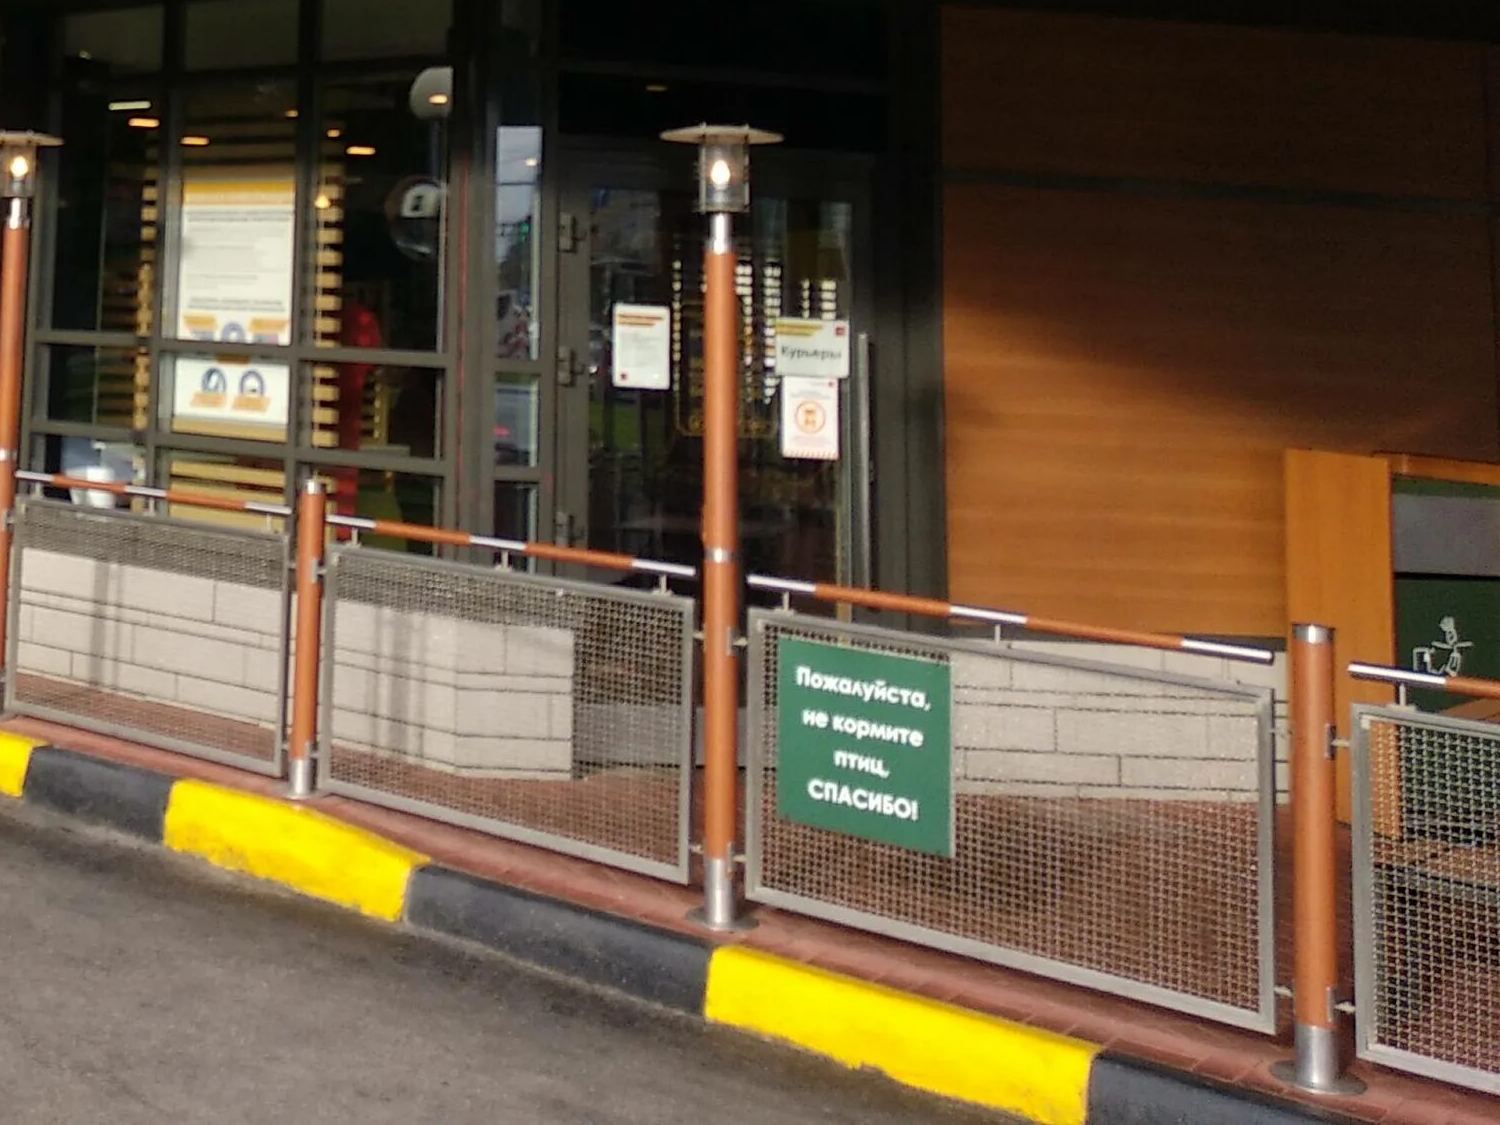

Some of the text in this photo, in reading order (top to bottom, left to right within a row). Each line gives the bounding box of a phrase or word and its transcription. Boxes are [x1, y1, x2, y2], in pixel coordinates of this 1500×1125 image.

[796, 666, 931, 711] Пожалуйста,
[803, 709, 924, 747] не кормите
[807, 779, 919, 822] СПАСИБО!
